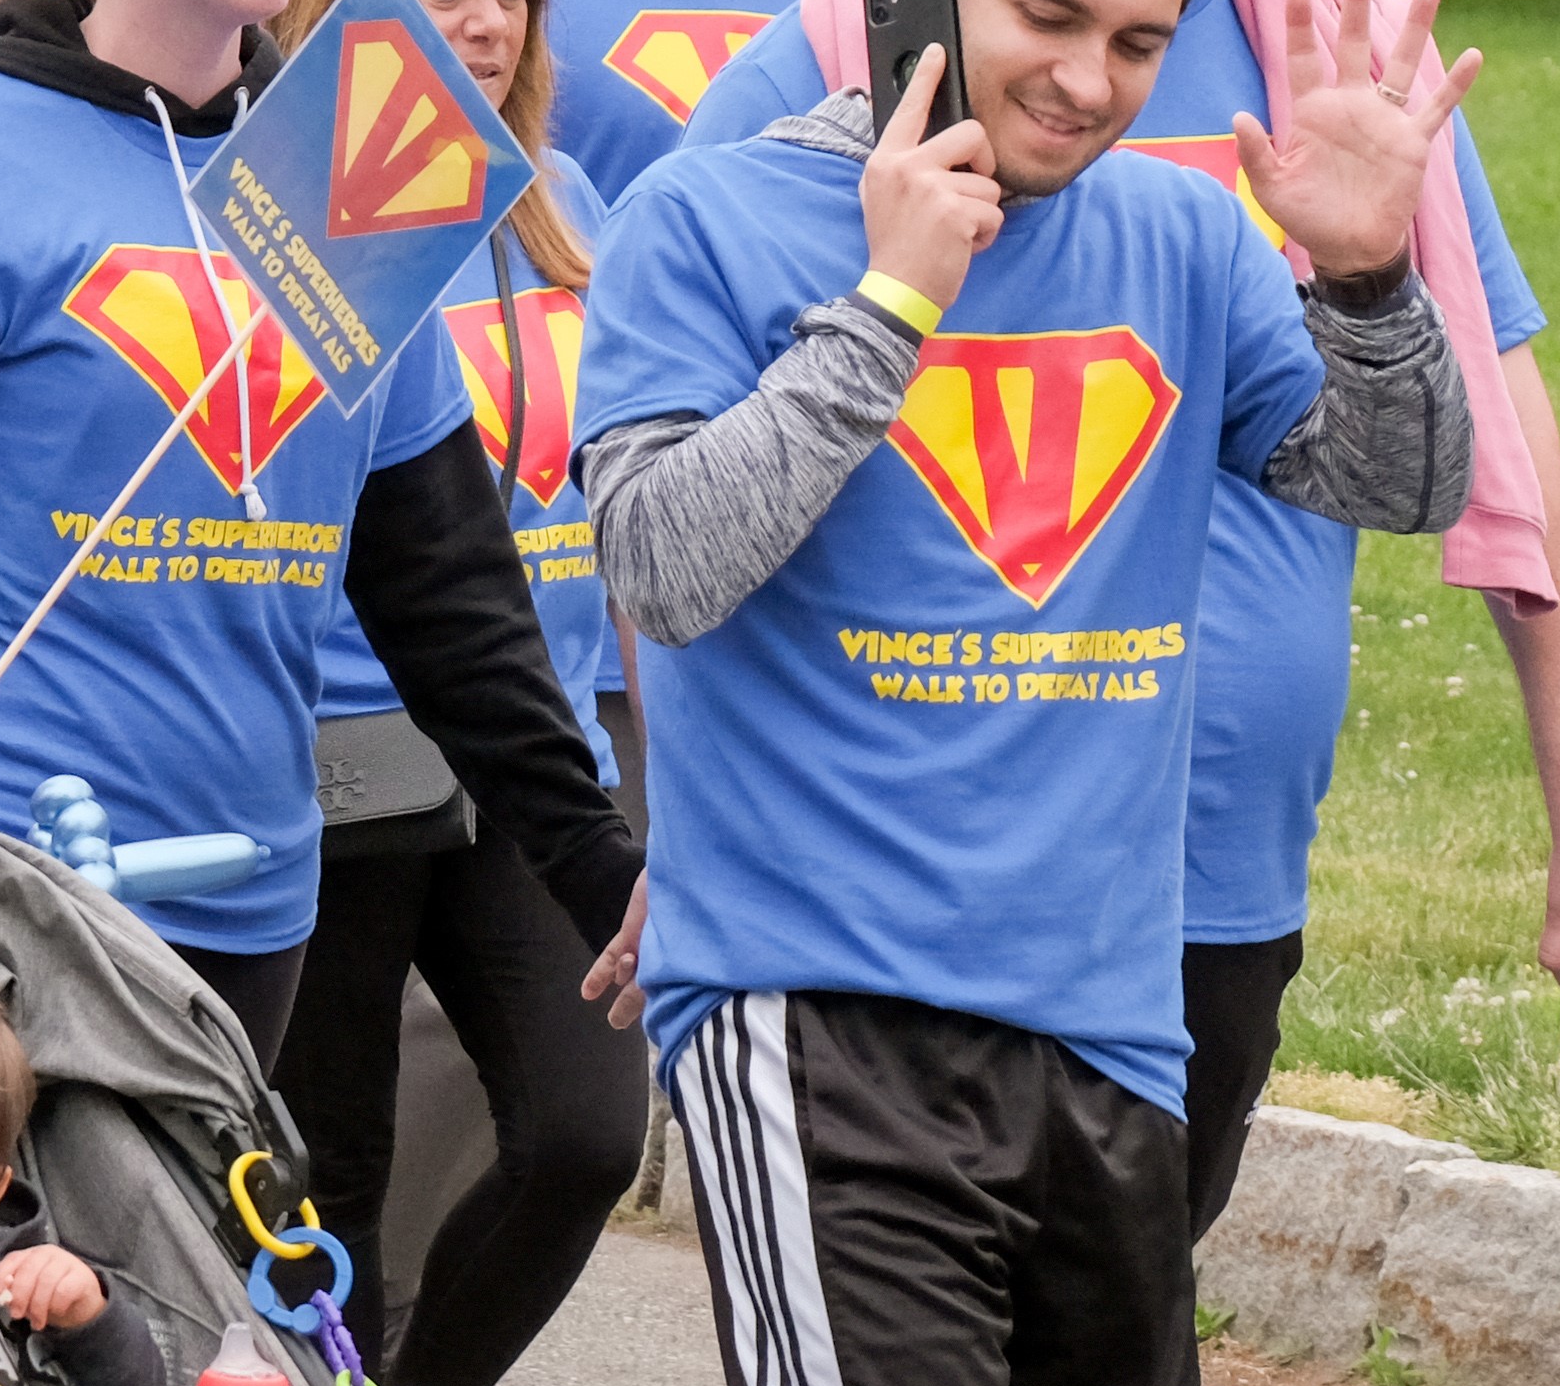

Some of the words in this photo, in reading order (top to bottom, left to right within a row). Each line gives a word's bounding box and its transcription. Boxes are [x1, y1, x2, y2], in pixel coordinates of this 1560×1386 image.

[229, 157, 293, 241] VINCE'S
[284, 235, 381, 367] SUPERHEROES
[222, 196, 267, 256] WALK
[261, 247, 285, 278] TO
[278, 272, 330, 340] DEFEAT
[322, 335, 352, 374] ALS
[166, 555, 199, 582] TO
[281, 560, 326, 587] ALS
[837, 628, 982, 666] VINCE'S
[989, 623, 1185, 665] SUPERHEROES
[870, 672, 965, 703] WALK
[971, 673, 1010, 703] TO
[1016, 672, 1100, 701] DEFEAT
[1102, 670, 1159, 702] ALS
